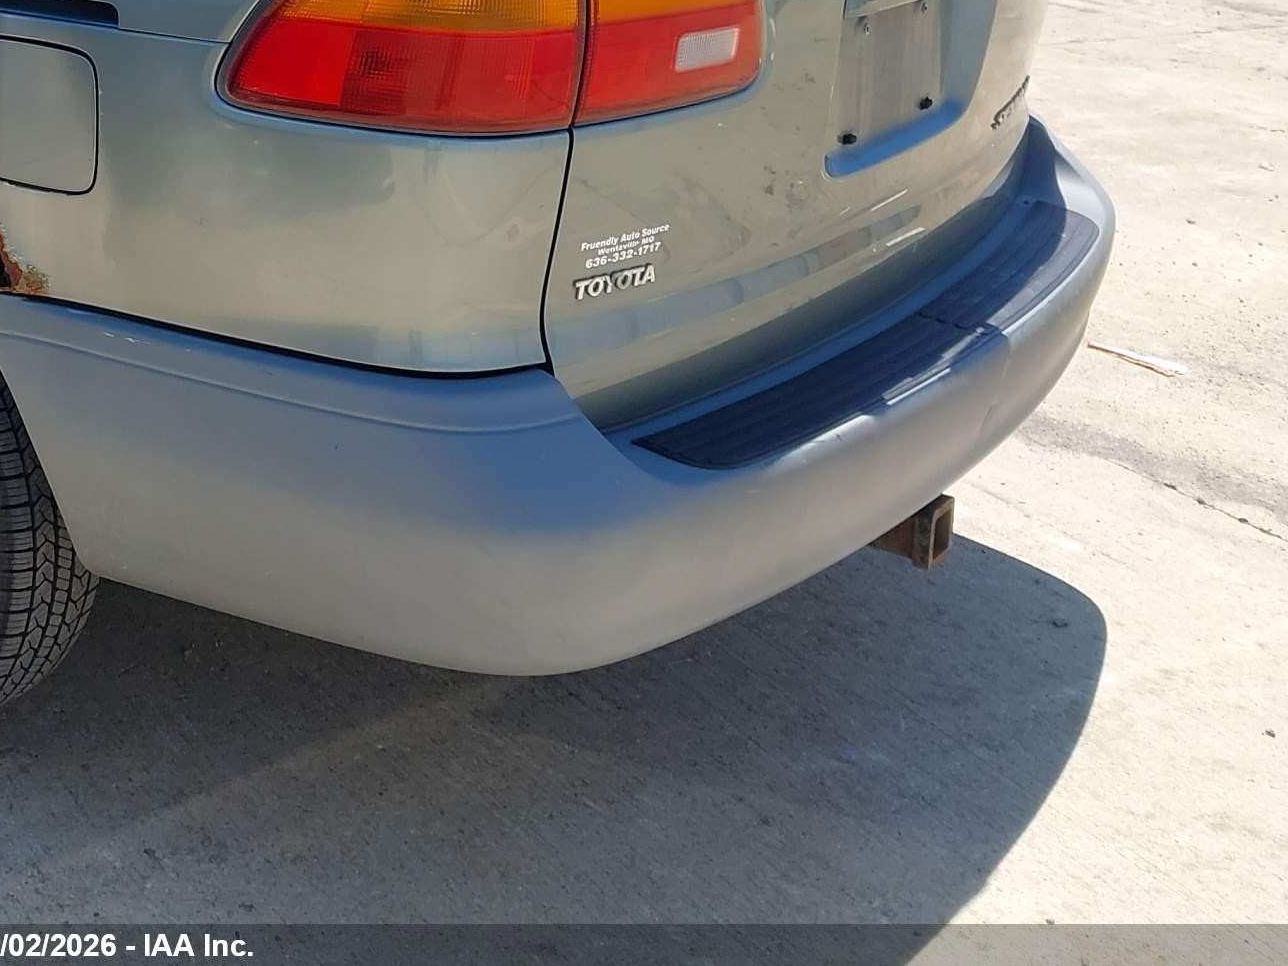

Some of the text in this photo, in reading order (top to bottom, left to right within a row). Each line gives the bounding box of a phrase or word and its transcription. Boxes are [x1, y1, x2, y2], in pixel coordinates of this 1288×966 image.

[620, 232, 640, 243] Auto
[641, 223, 670, 237] Source
[641, 236, 655, 245] MO
[585, 241, 661, 269] 636-332-1717
[572, 263, 656, 301] TOYOTA
